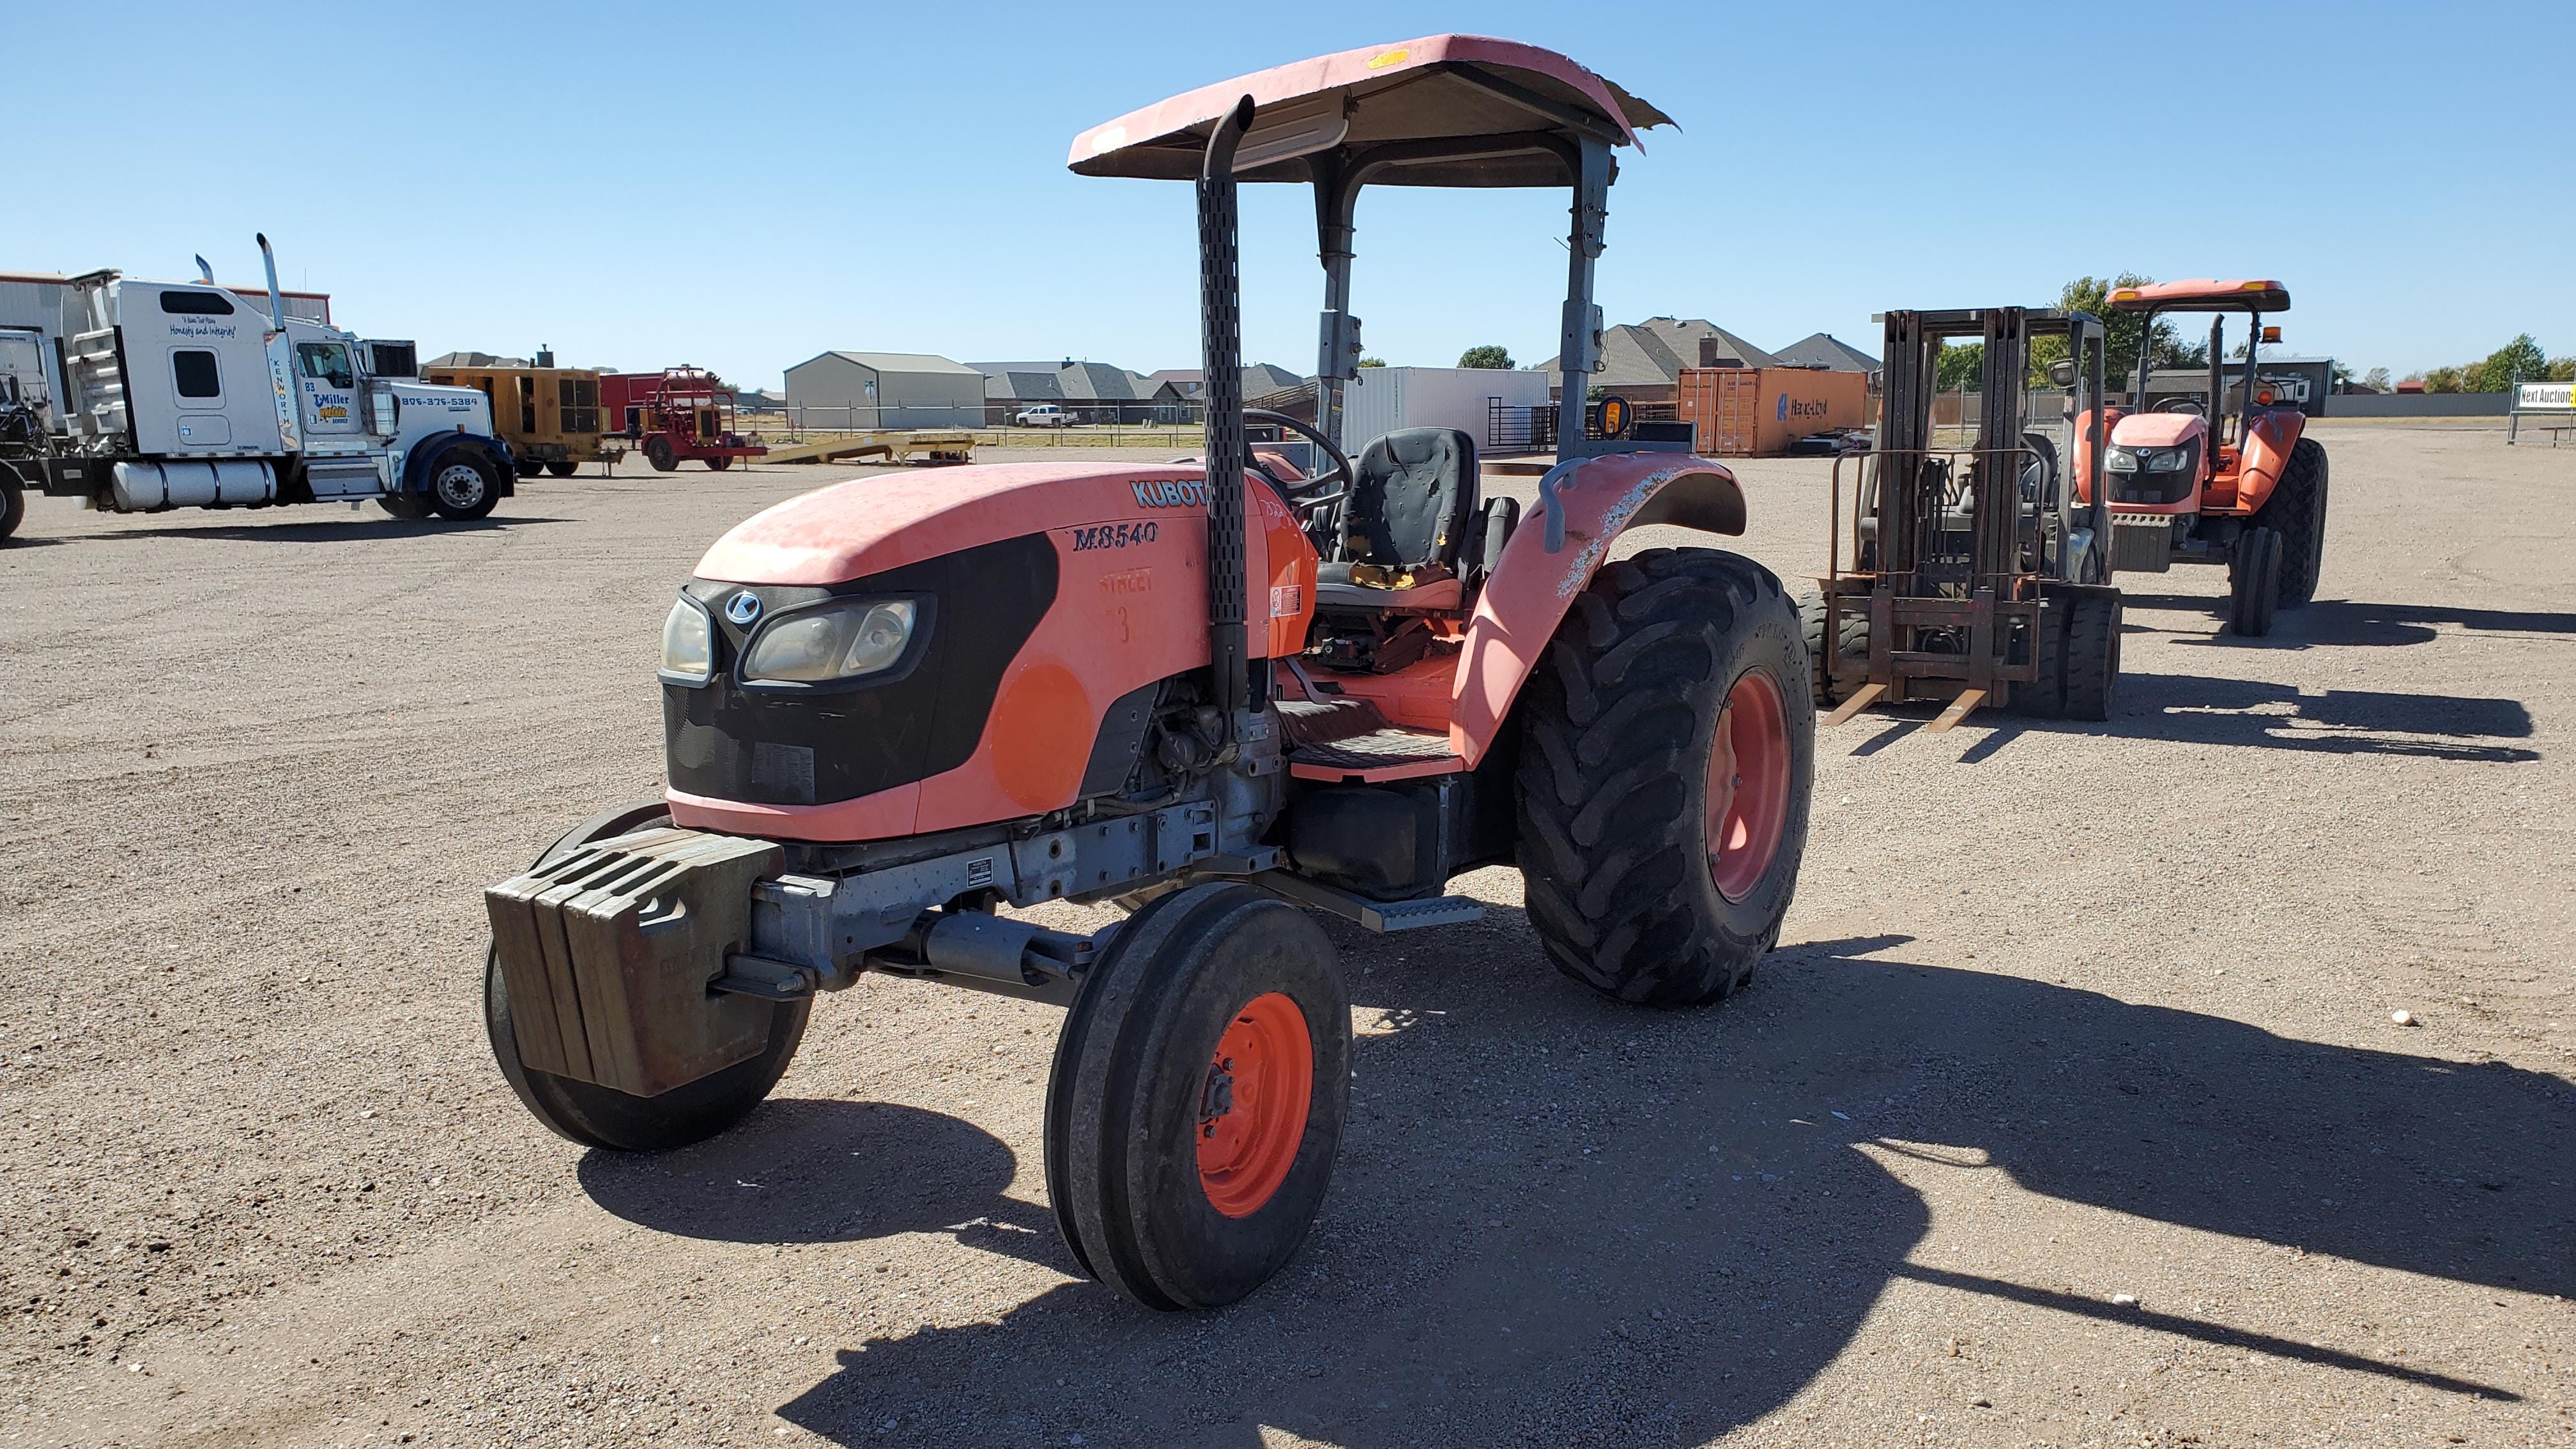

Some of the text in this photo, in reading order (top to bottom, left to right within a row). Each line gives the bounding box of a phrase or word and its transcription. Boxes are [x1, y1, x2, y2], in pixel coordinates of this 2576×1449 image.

[169, 324, 194, 338] Honesty
[195, 326, 208, 335] and
[273, 360, 290, 425] KENWORTH
[305, 382, 315, 392] 83
[2521, 388, 2538, 403] Next
[1130, 479, 1208, 509] KUBOT
[1073, 521, 1159, 551] M8540
